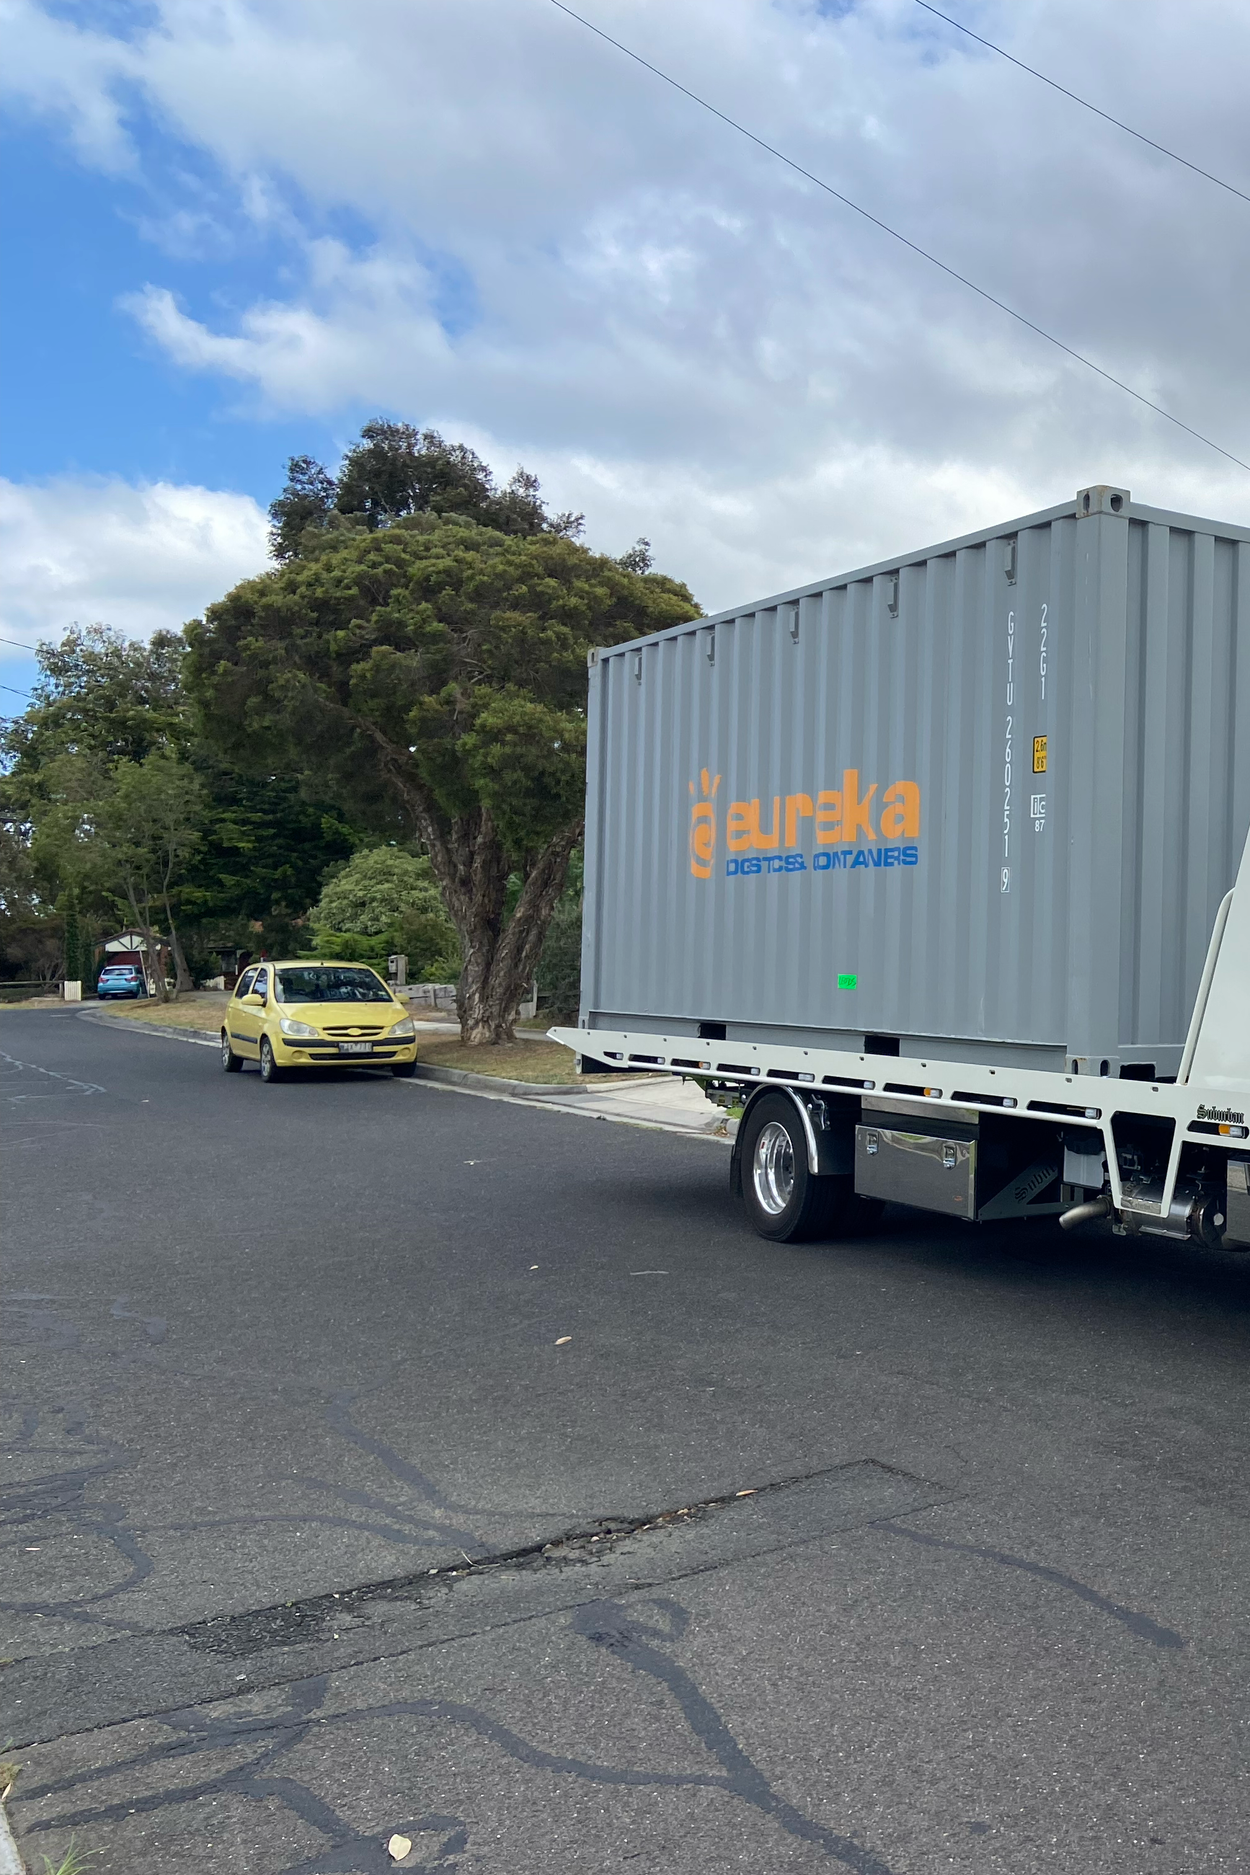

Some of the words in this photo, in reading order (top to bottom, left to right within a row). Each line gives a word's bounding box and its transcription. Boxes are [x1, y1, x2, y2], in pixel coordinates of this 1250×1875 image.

[1006, 611, 1014, 706] GVTU
[1040, 603, 1048, 700] 22G1
[726, 768, 920, 851] eureka
[1003, 715, 1013, 858] 260251
[1034, 819, 1046, 832] 87
[1001, 868, 1009, 891] 9
[1196, 1103, 1245, 1124] Suburban
